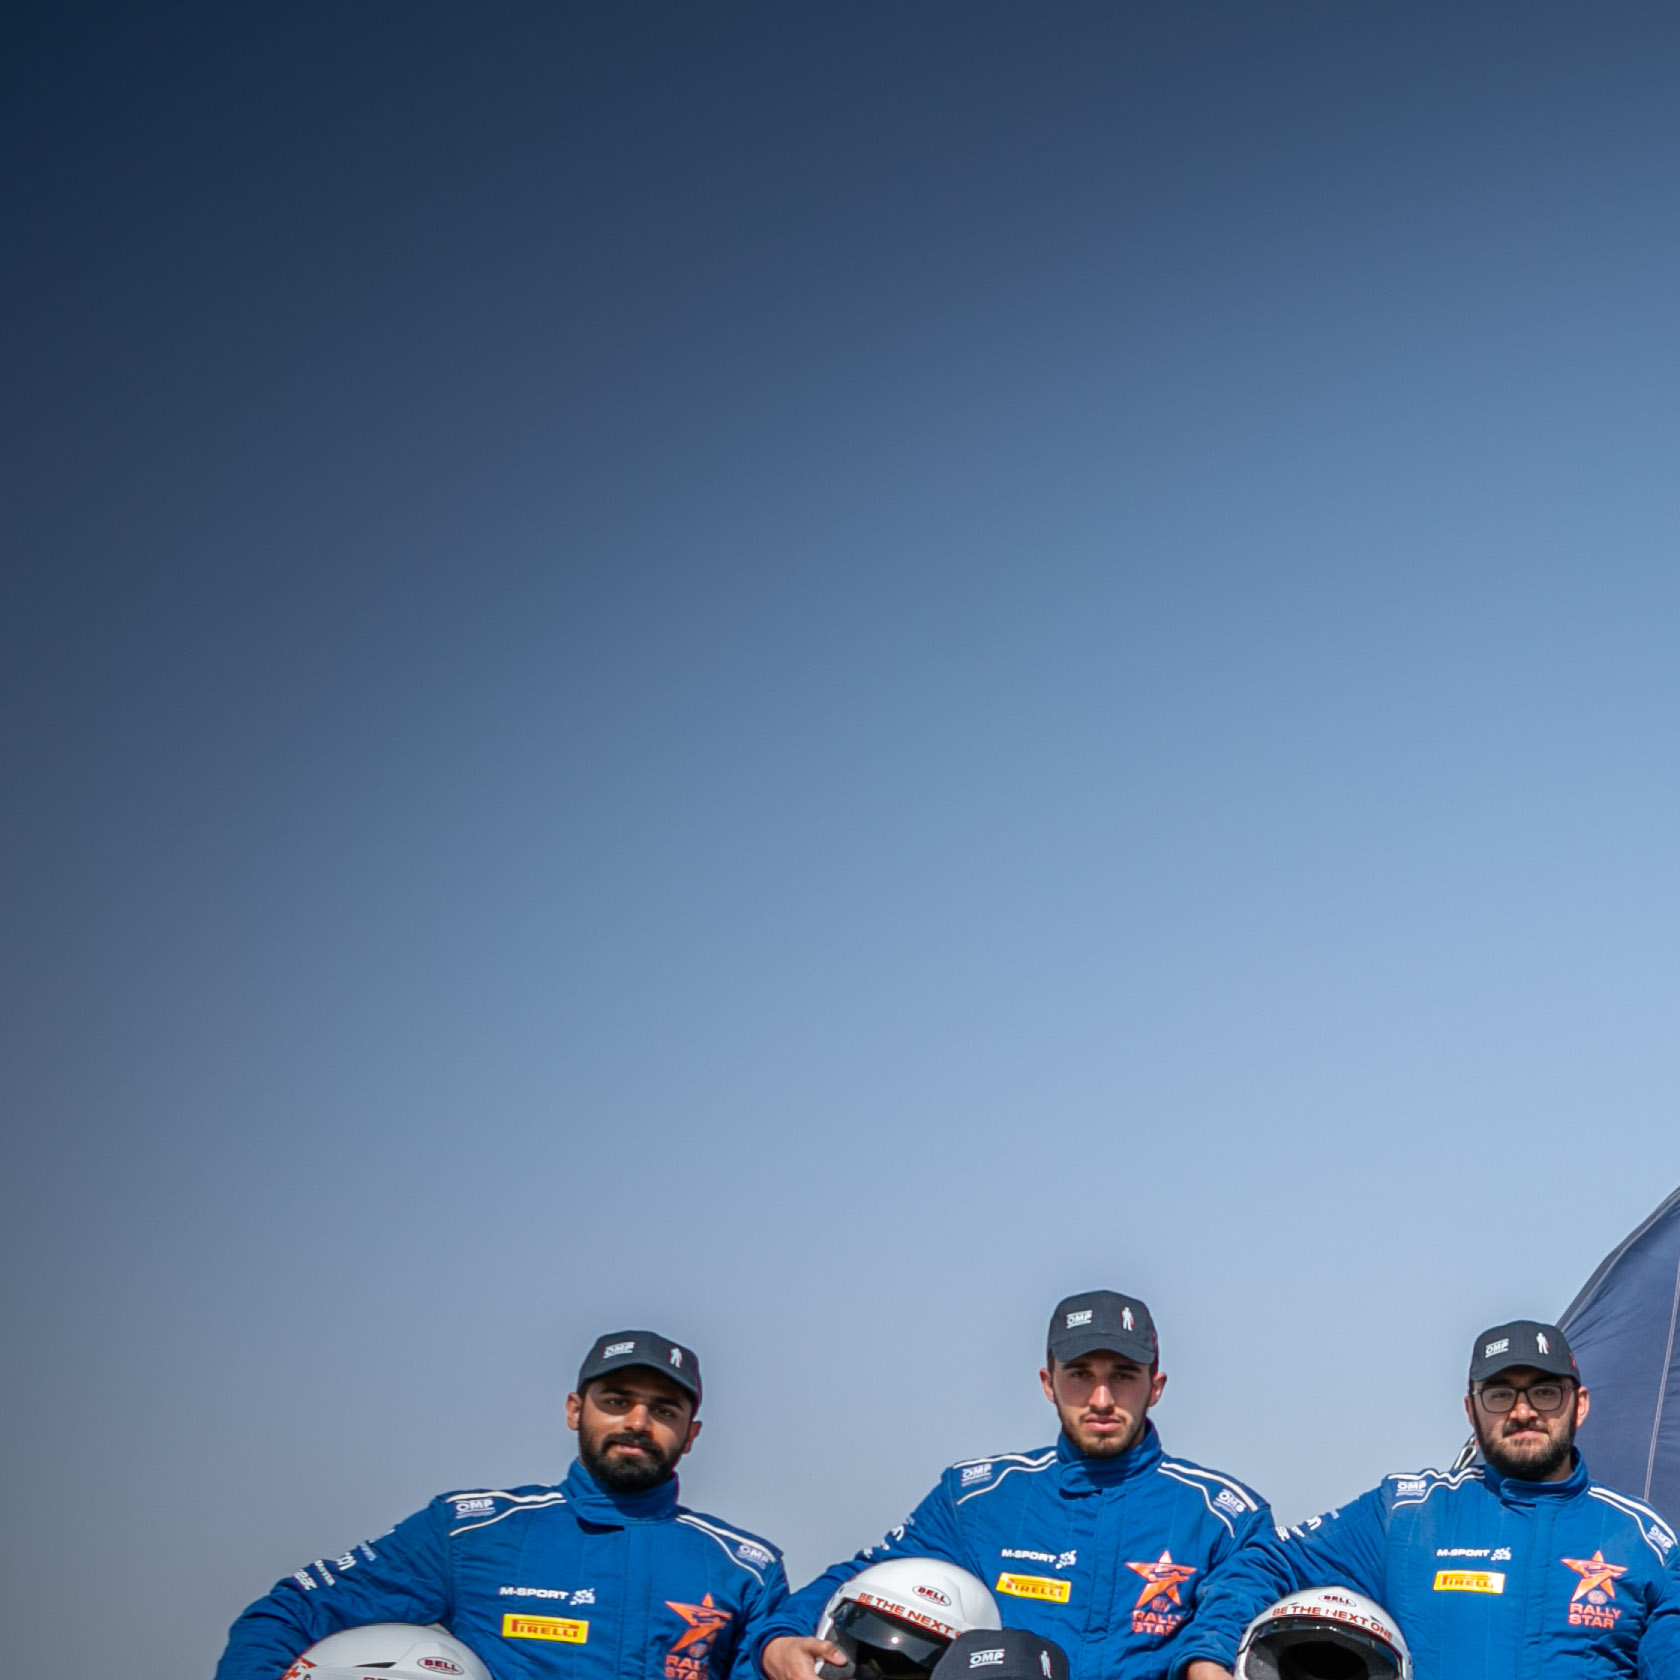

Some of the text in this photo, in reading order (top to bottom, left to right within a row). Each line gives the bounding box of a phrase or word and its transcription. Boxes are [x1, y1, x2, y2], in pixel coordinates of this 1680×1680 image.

[1066, 1312, 1093, 1326] OMP
[963, 1464, 992, 1480] OMP
[1397, 1480, 1427, 1491] OMP
[456, 1500, 495, 1512] OMP
[1001, 1549, 1056, 1563] M-SPORT
[1437, 1549, 1490, 1559] M-SPORT
[499, 1587, 569, 1601] M-SPORT
[918, 1587, 946, 1604] BELL
[1006, 1579, 1063, 1598] PIRELLI
[1322, 1595, 1350, 1605] BELL
[858, 1593, 956, 1634] BE THE NEXT
[1569, 1603, 1621, 1619] RALLY
[512, 1619, 580, 1639] PIRELLI
[1272, 1605, 1394, 1642] BE THE NEXT ONE
[1568, 1614, 1615, 1630] STAR
[970, 1651, 1005, 1665] OMP
[423, 1659, 459, 1673] BELL
